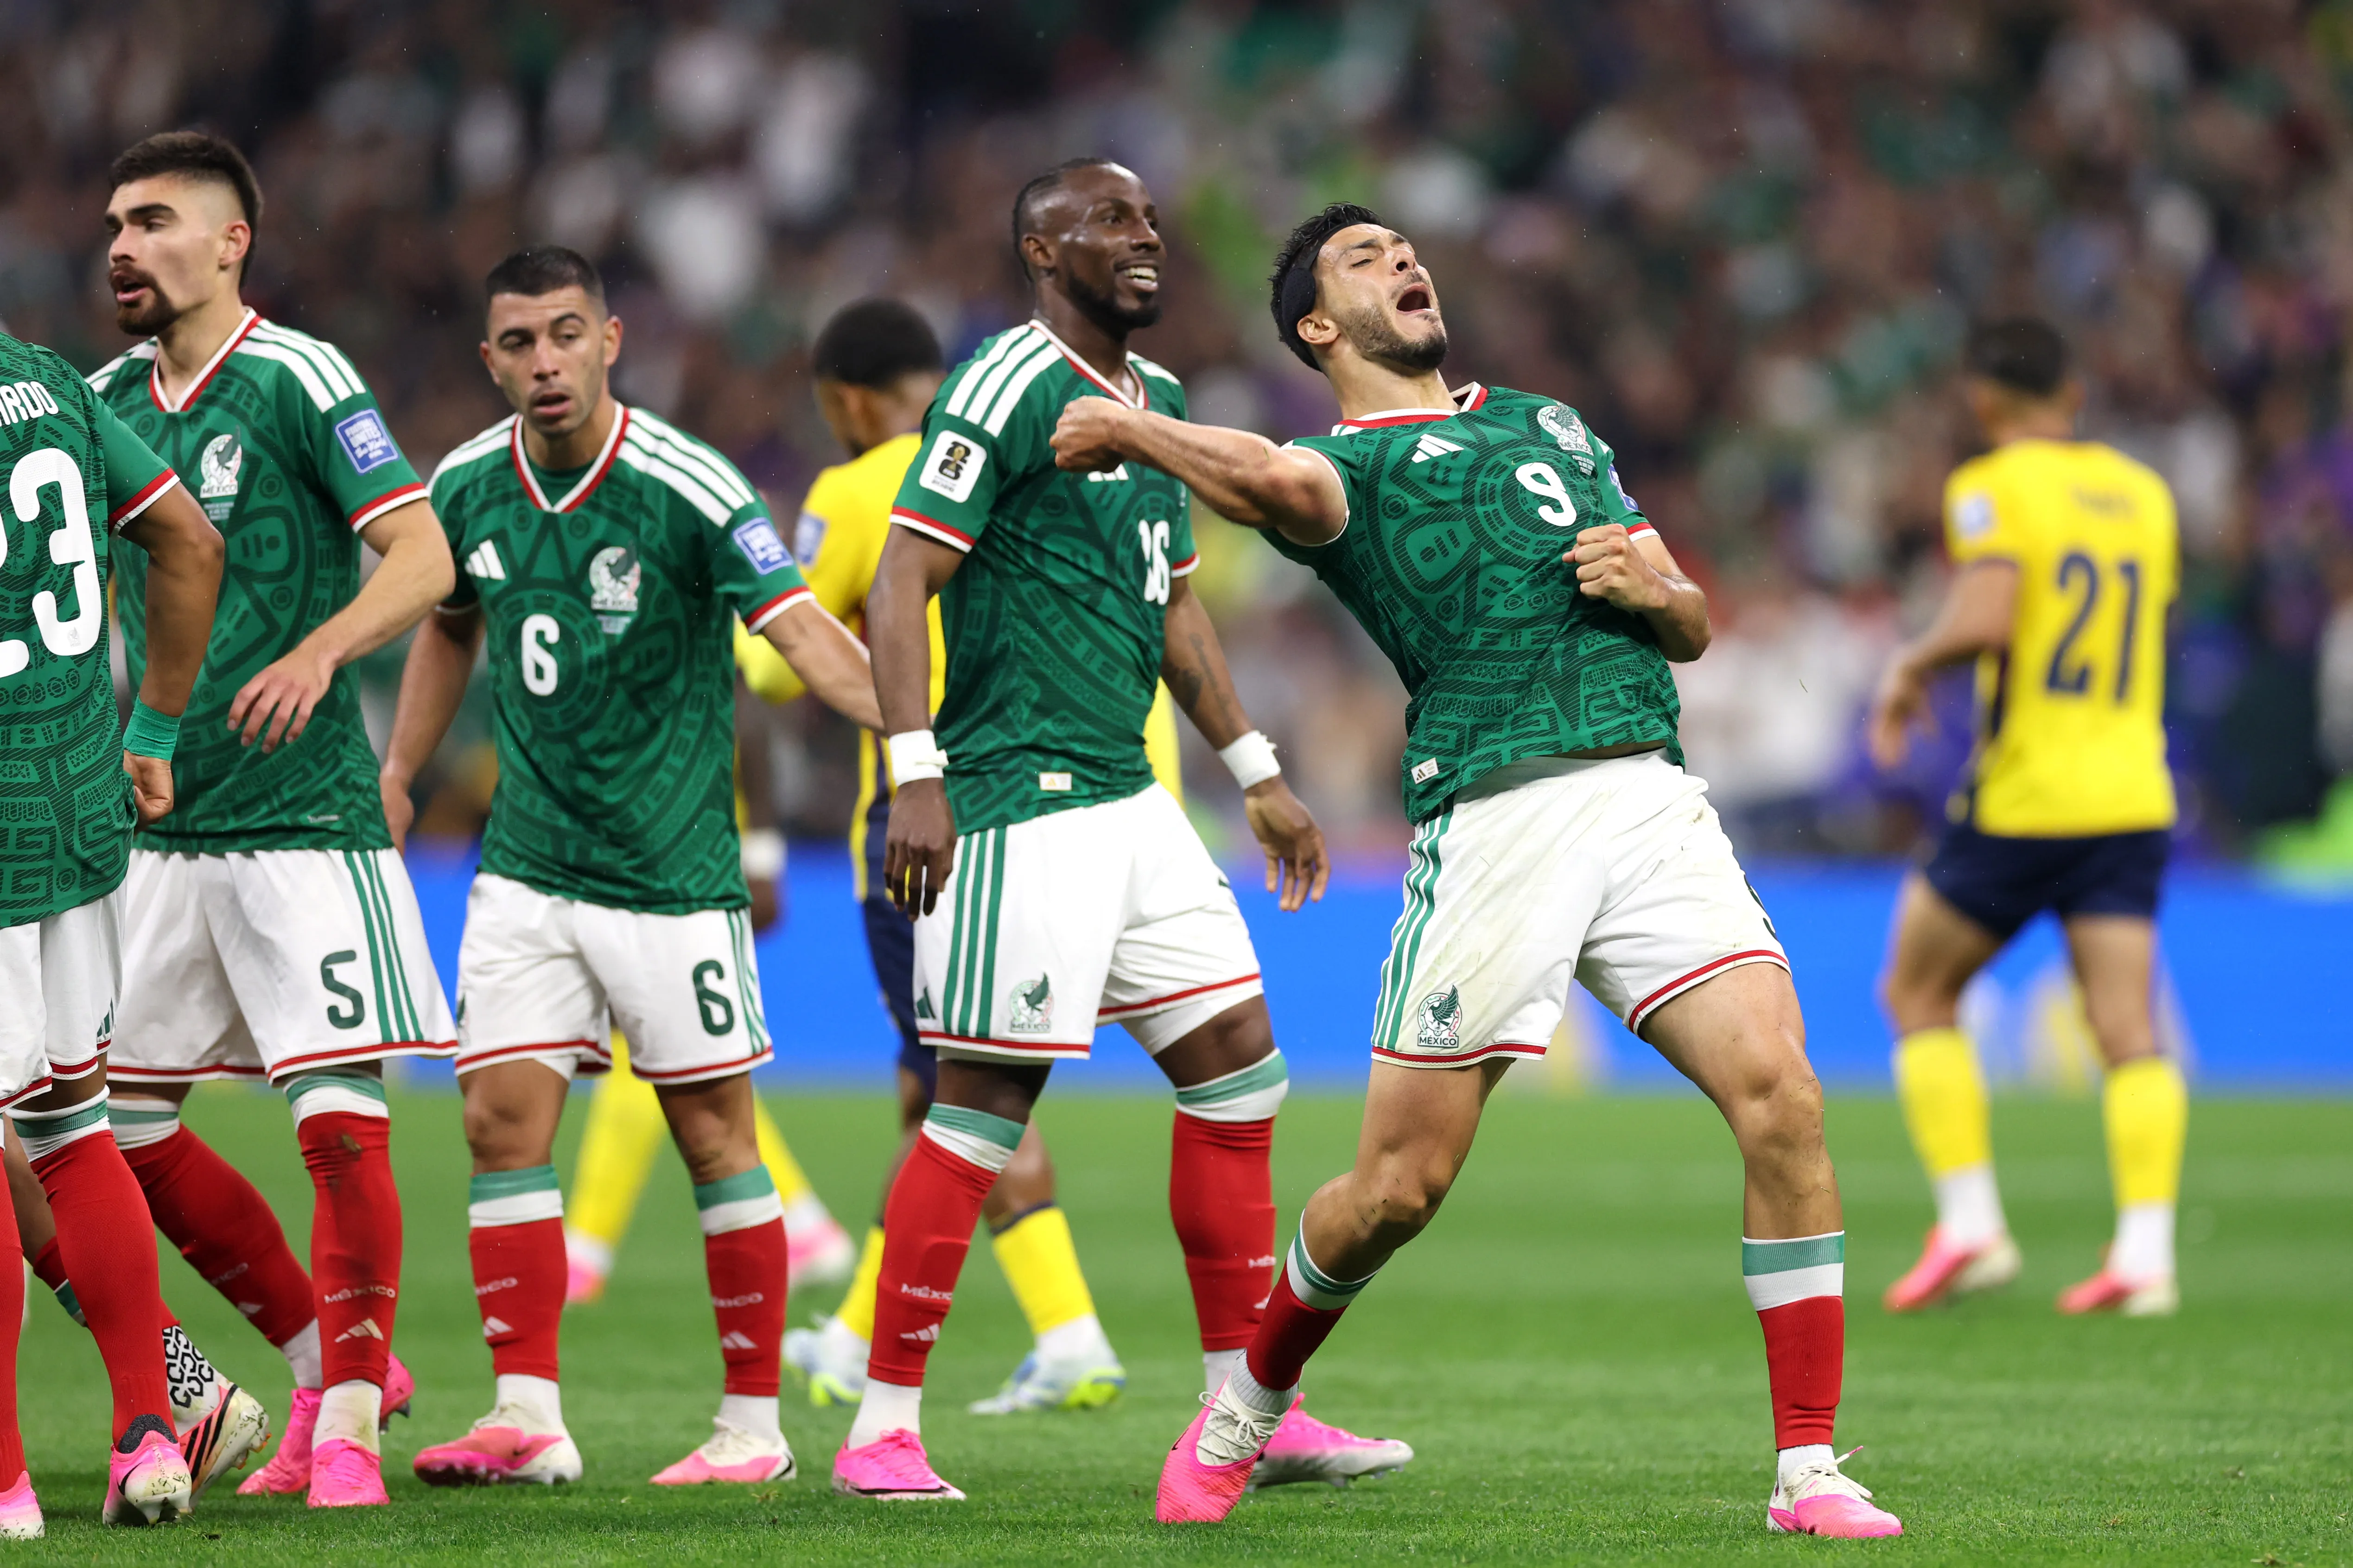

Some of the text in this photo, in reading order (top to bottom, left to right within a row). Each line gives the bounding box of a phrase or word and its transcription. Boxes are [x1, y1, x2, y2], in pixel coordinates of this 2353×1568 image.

[1559, 440, 1592, 453] MÉXICO
[1515, 463, 1577, 527] 9
[1138, 519, 1170, 605] 16
[521, 614, 560, 696] 6
[2045, 549, 2141, 706] 21
[320, 950, 364, 1029] 5
[693, 960, 734, 1035] 6
[1419, 1035, 1456, 1046] MÉXICO
